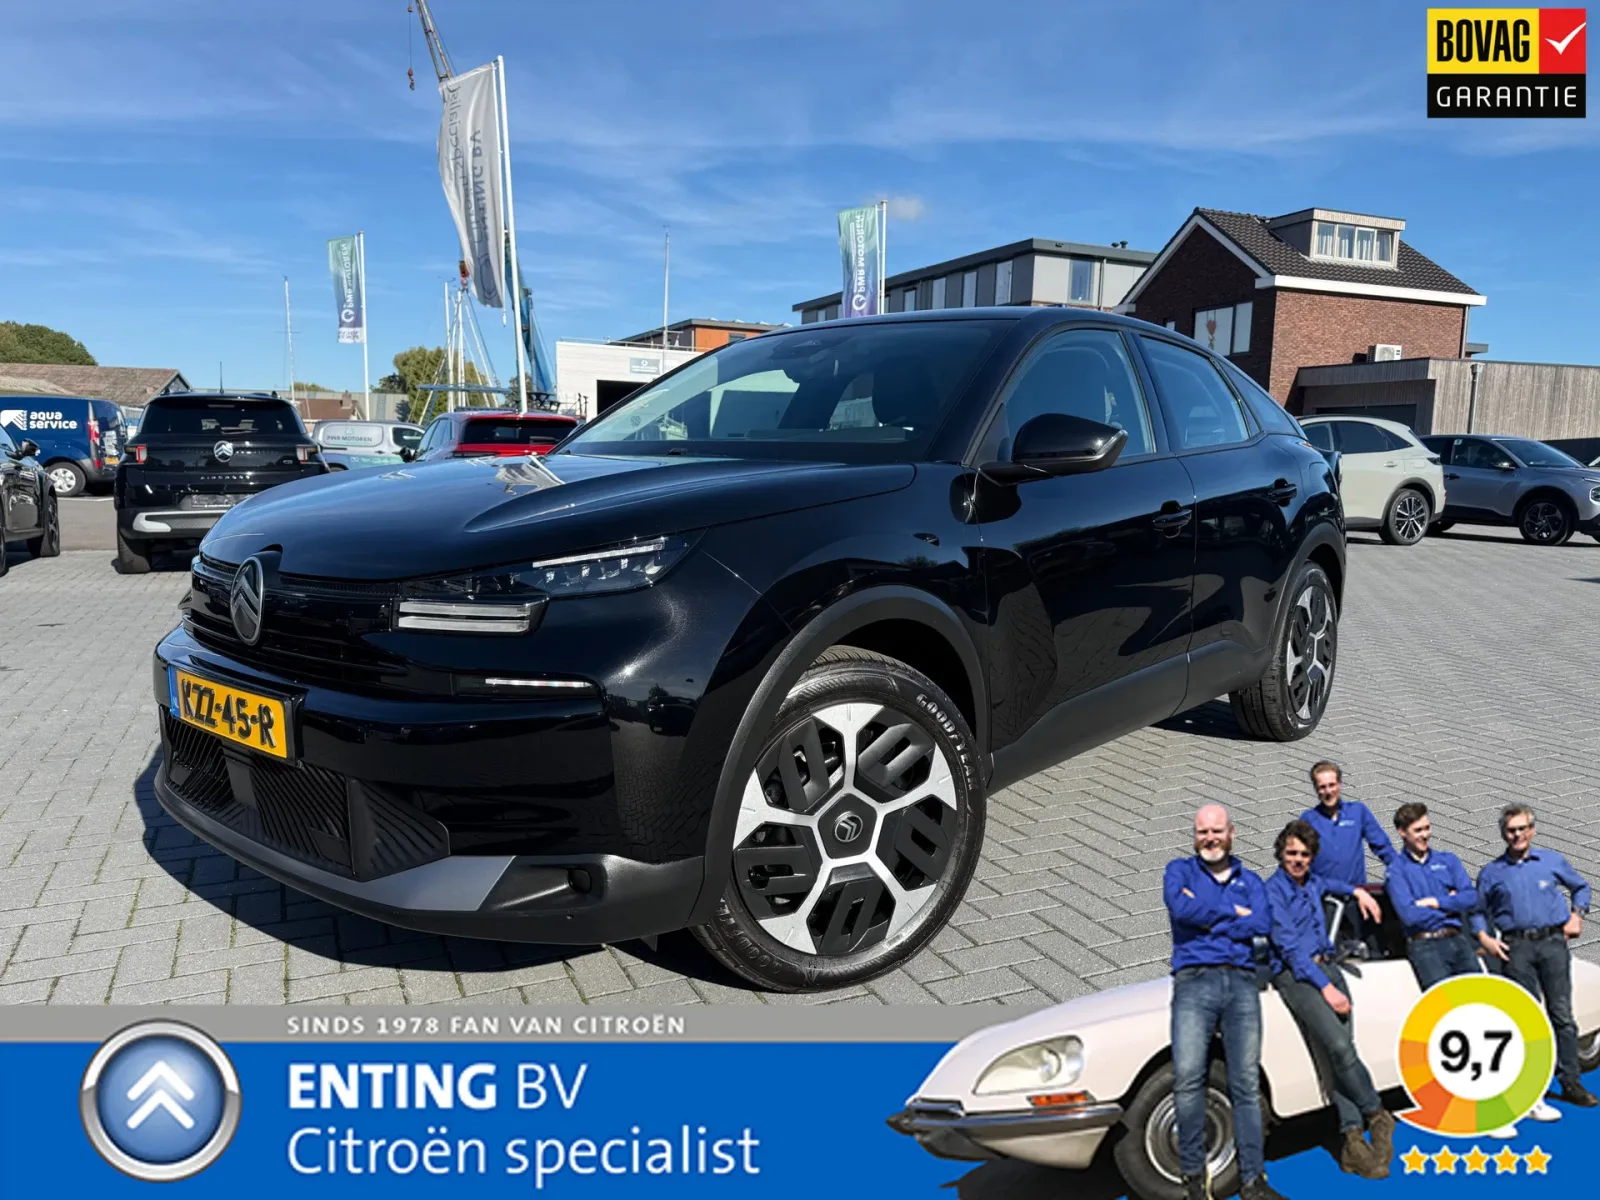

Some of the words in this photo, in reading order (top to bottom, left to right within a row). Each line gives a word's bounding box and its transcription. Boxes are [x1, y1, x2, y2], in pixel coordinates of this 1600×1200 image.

[30, 411, 62, 421] aqua
[30, 420, 77, 429] service
[182, 678, 276, 748] KZZ-45-R
